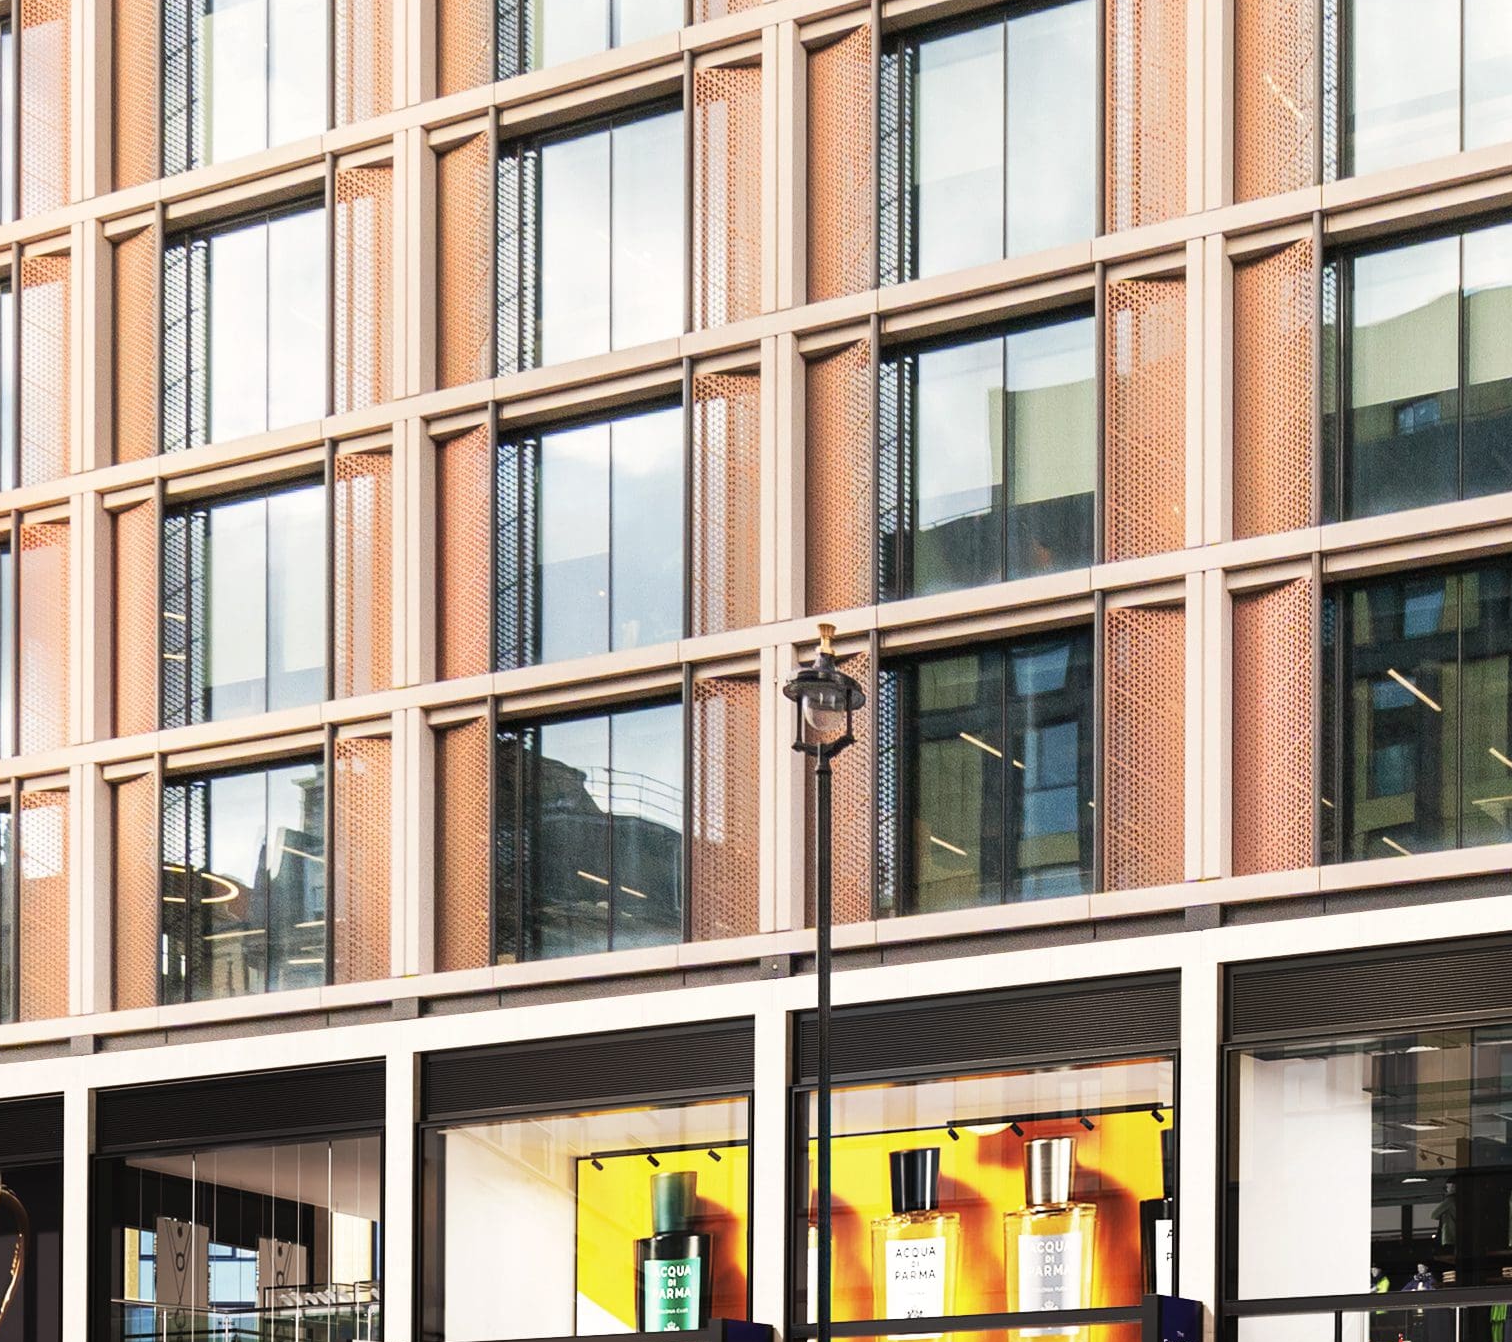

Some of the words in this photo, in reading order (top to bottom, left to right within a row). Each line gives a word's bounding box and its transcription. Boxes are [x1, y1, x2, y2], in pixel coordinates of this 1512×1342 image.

[896, 1246, 936, 1258] ACQUA
[1045, 1255, 1055, 1263] DI
[895, 1269, 936, 1281] PARMA
[667, 1279, 677, 1287] DI
